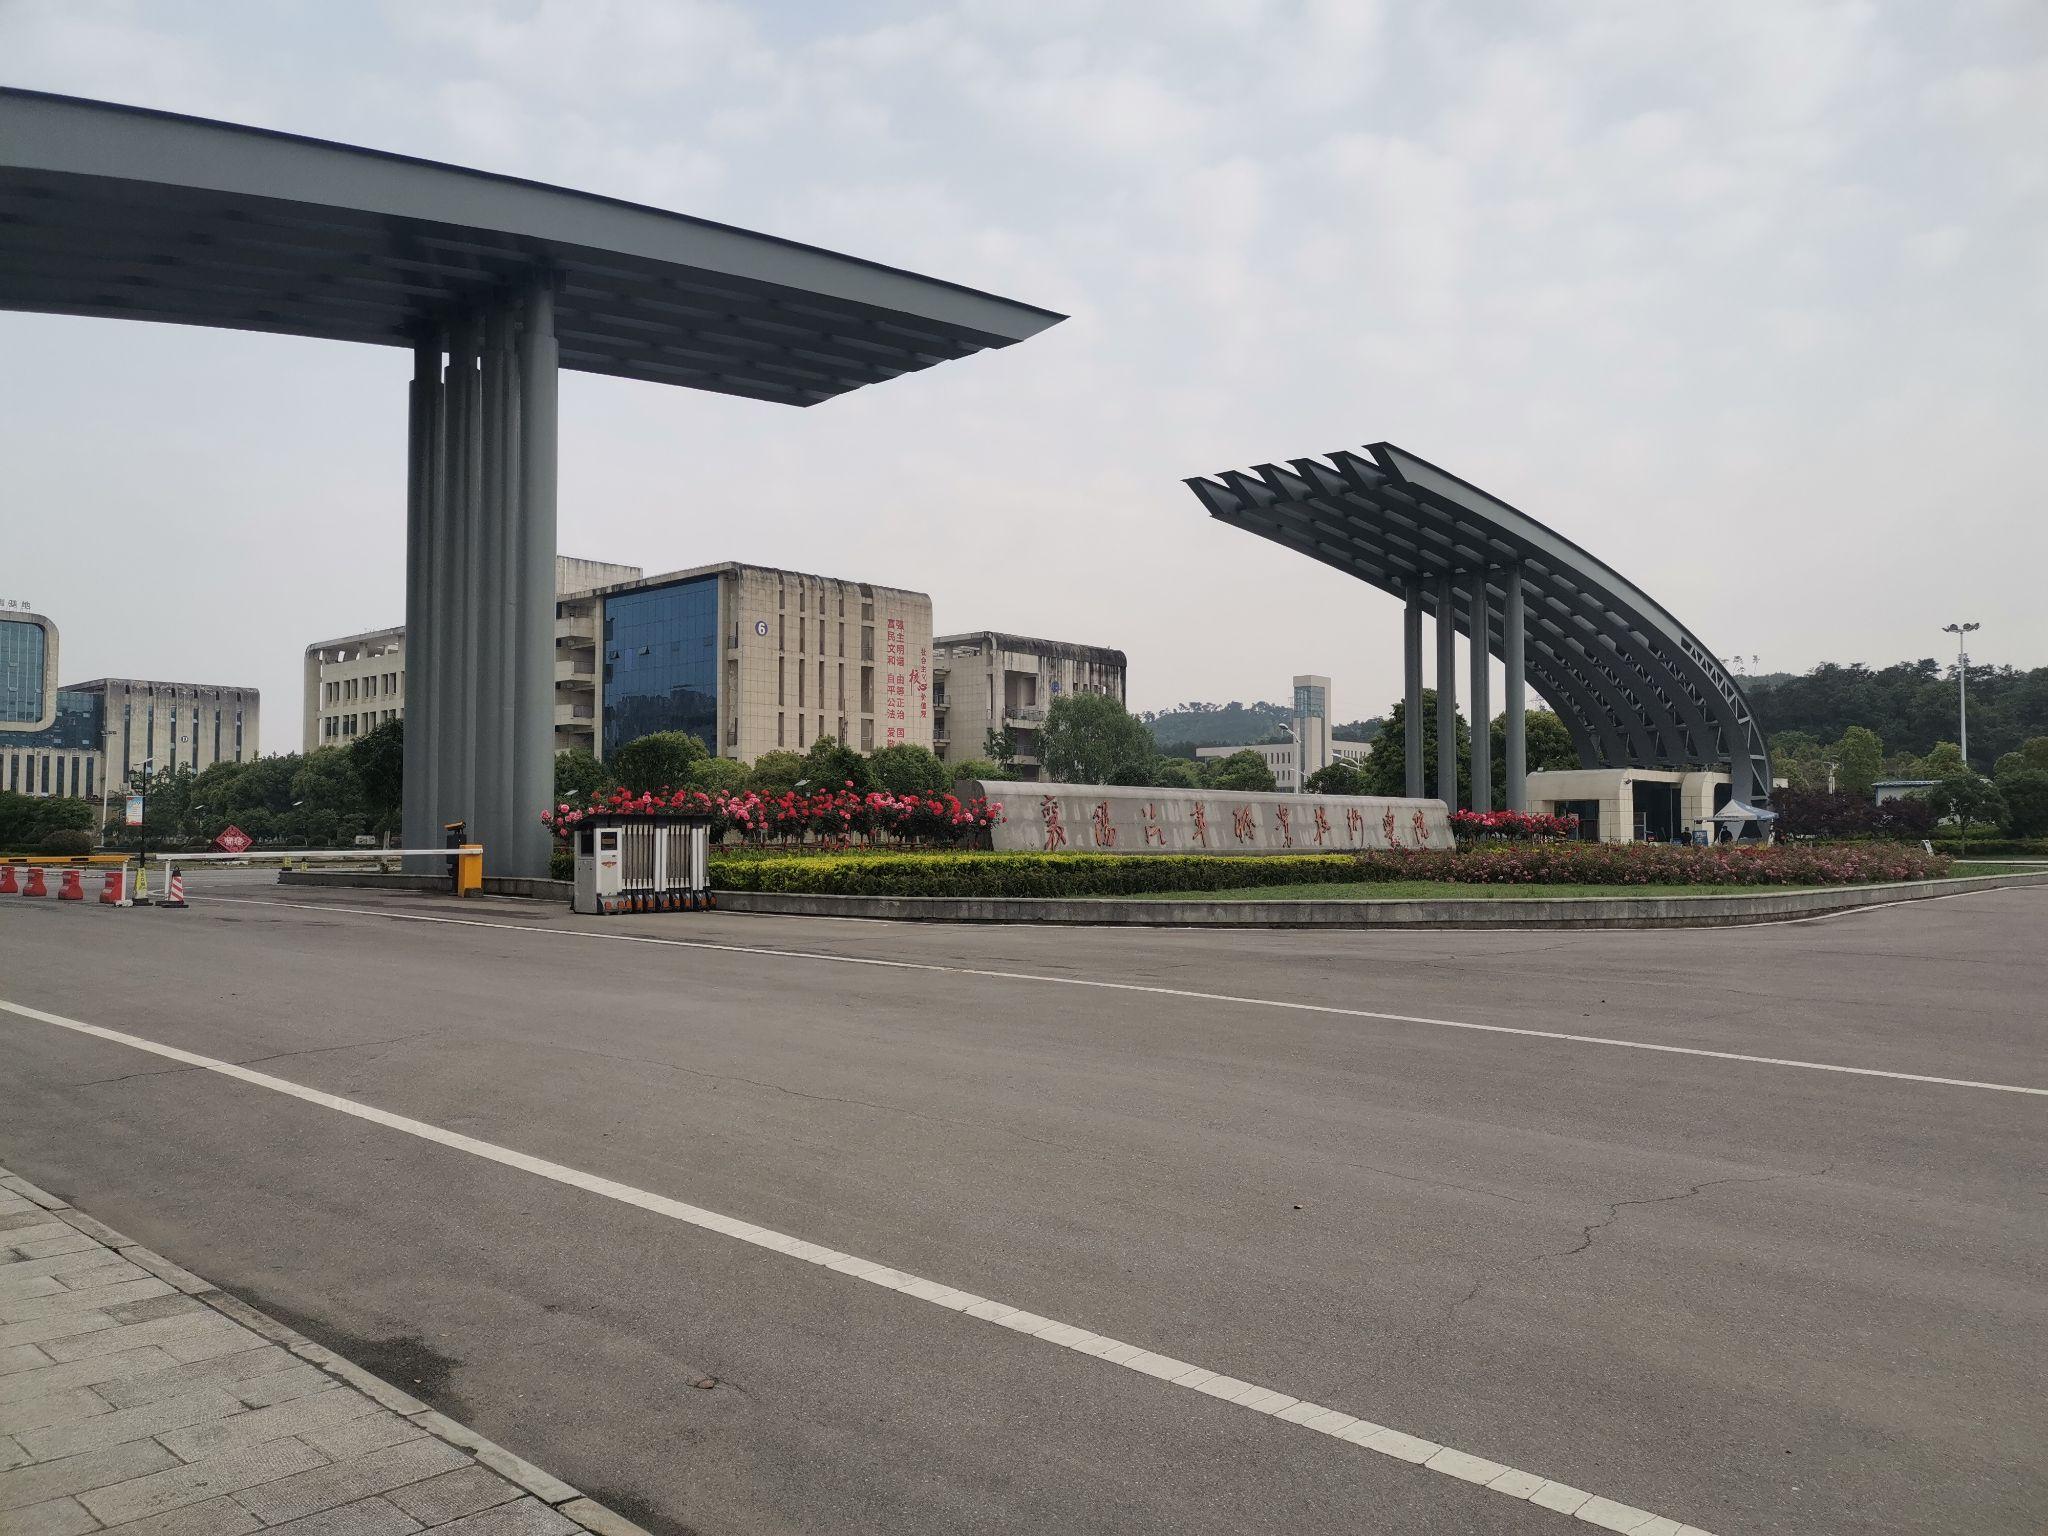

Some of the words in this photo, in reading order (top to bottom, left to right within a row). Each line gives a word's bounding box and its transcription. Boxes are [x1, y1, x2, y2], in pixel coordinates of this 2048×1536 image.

[887, 619, 905, 630] 富强
[887, 631, 905, 643] 民主
[887, 644, 905, 655] 文明
[887, 655, 905, 667] 和谐
[887, 673, 905, 684] 自由
[887, 686, 905, 696] 平等
[887, 698, 905, 708] 公正
[887, 709, 905, 720] 法治
[887, 728, 905, 738] 爱国
